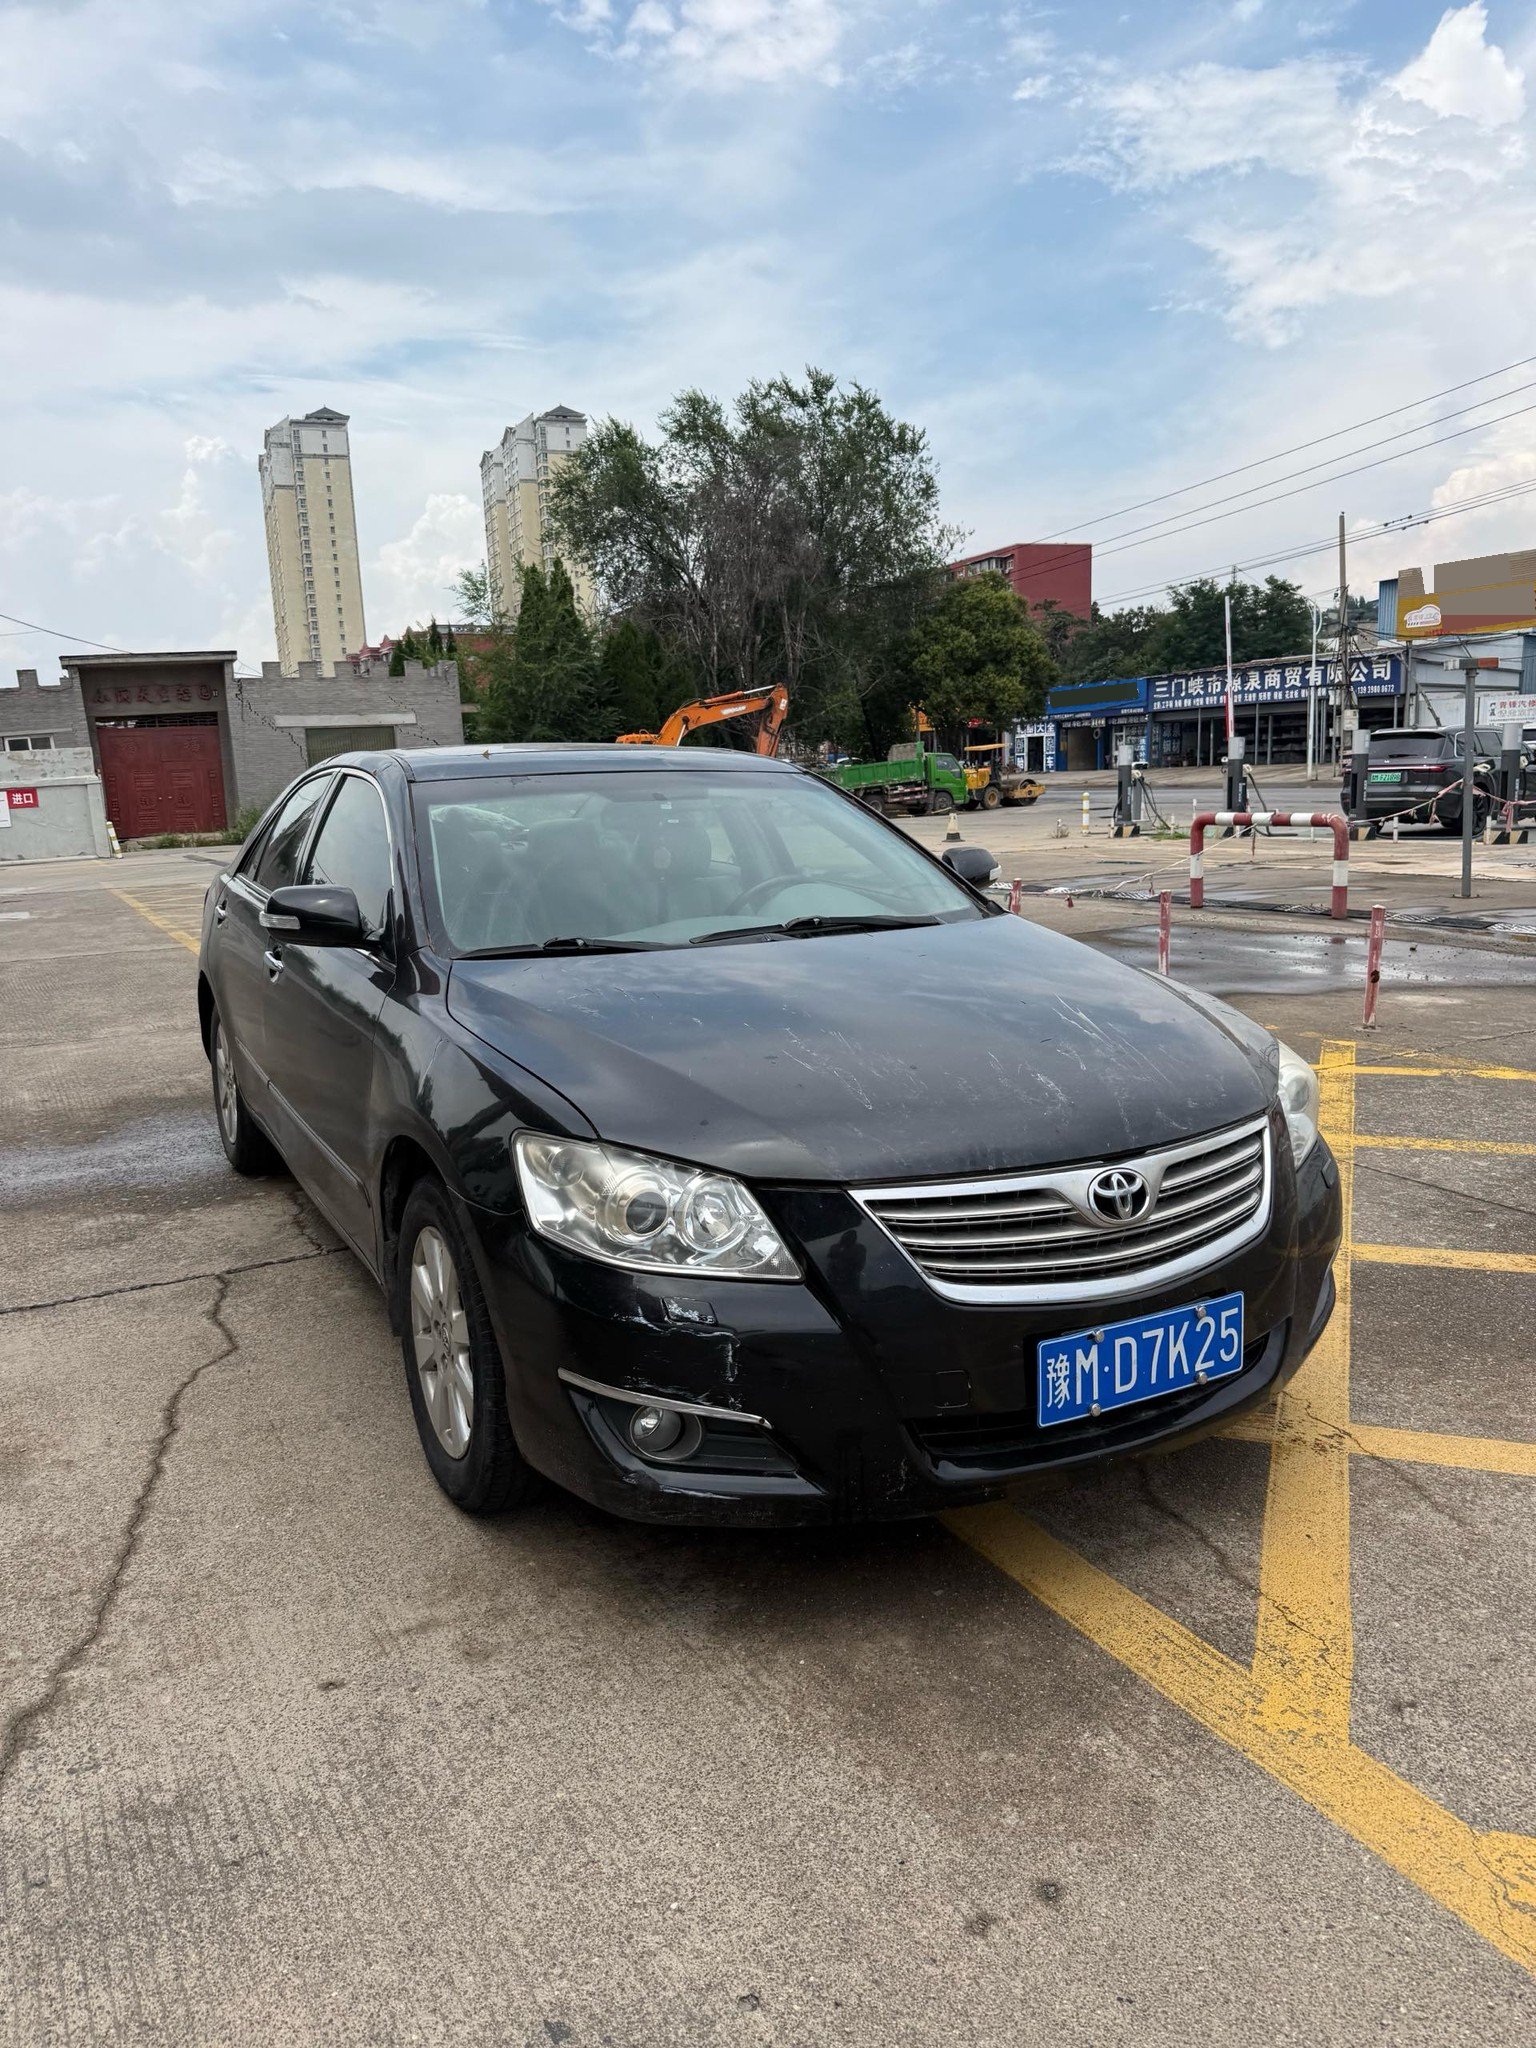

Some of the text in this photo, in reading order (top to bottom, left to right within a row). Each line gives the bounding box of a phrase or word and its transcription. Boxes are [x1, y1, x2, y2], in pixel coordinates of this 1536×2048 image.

[1153, 659, 1391, 698] 三门峡市源泉商贸有限公司
[12, 792, 34, 805] 进口
[1046, 1307, 1239, 1409] 豫M·D7K25
